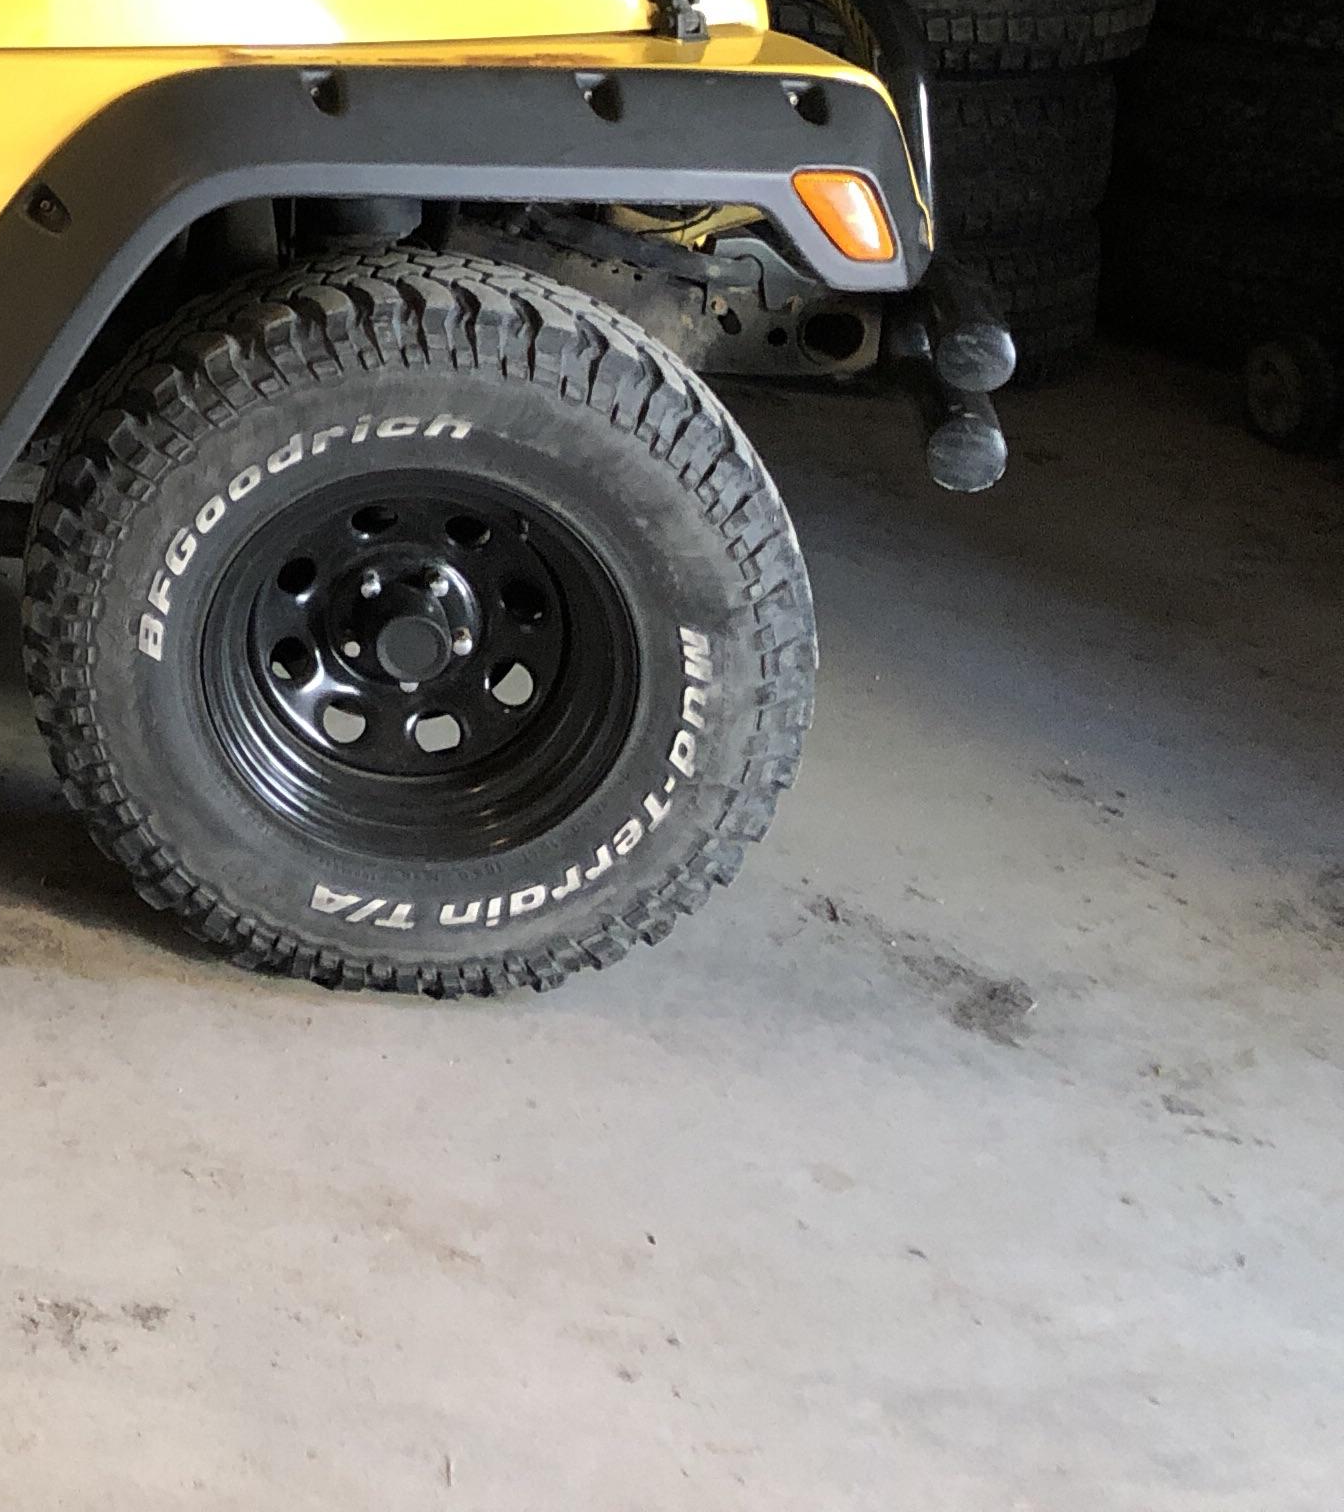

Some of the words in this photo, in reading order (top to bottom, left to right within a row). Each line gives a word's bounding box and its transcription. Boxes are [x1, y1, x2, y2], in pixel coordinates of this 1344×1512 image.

[138, 412, 473, 663] BFGoodrich
[439, 625, 713, 927] Mud-Terrain
[311, 884, 414, 929] T/A
